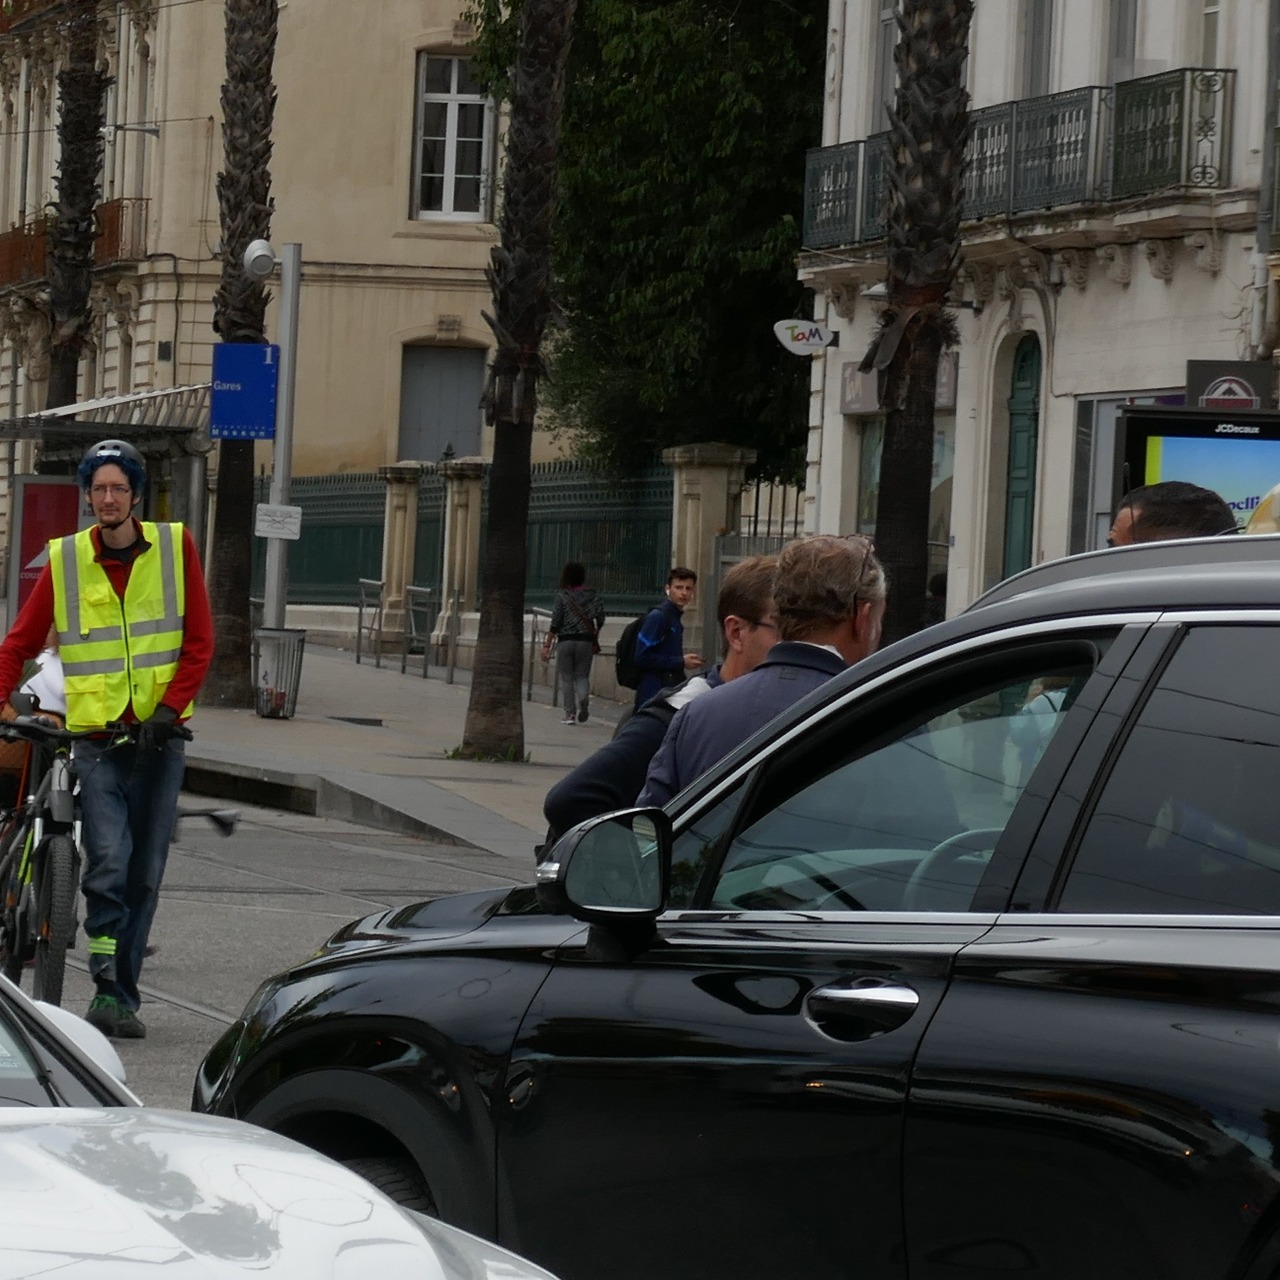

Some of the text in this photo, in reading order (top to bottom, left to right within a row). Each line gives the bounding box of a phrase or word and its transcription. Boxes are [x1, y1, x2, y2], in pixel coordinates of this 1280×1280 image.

[262, 346, 274, 365] 1
[213, 380, 242, 392] Gares
[211, 428, 266, 437] Mosson
[1214, 423, 1260, 434] JCDecaux
